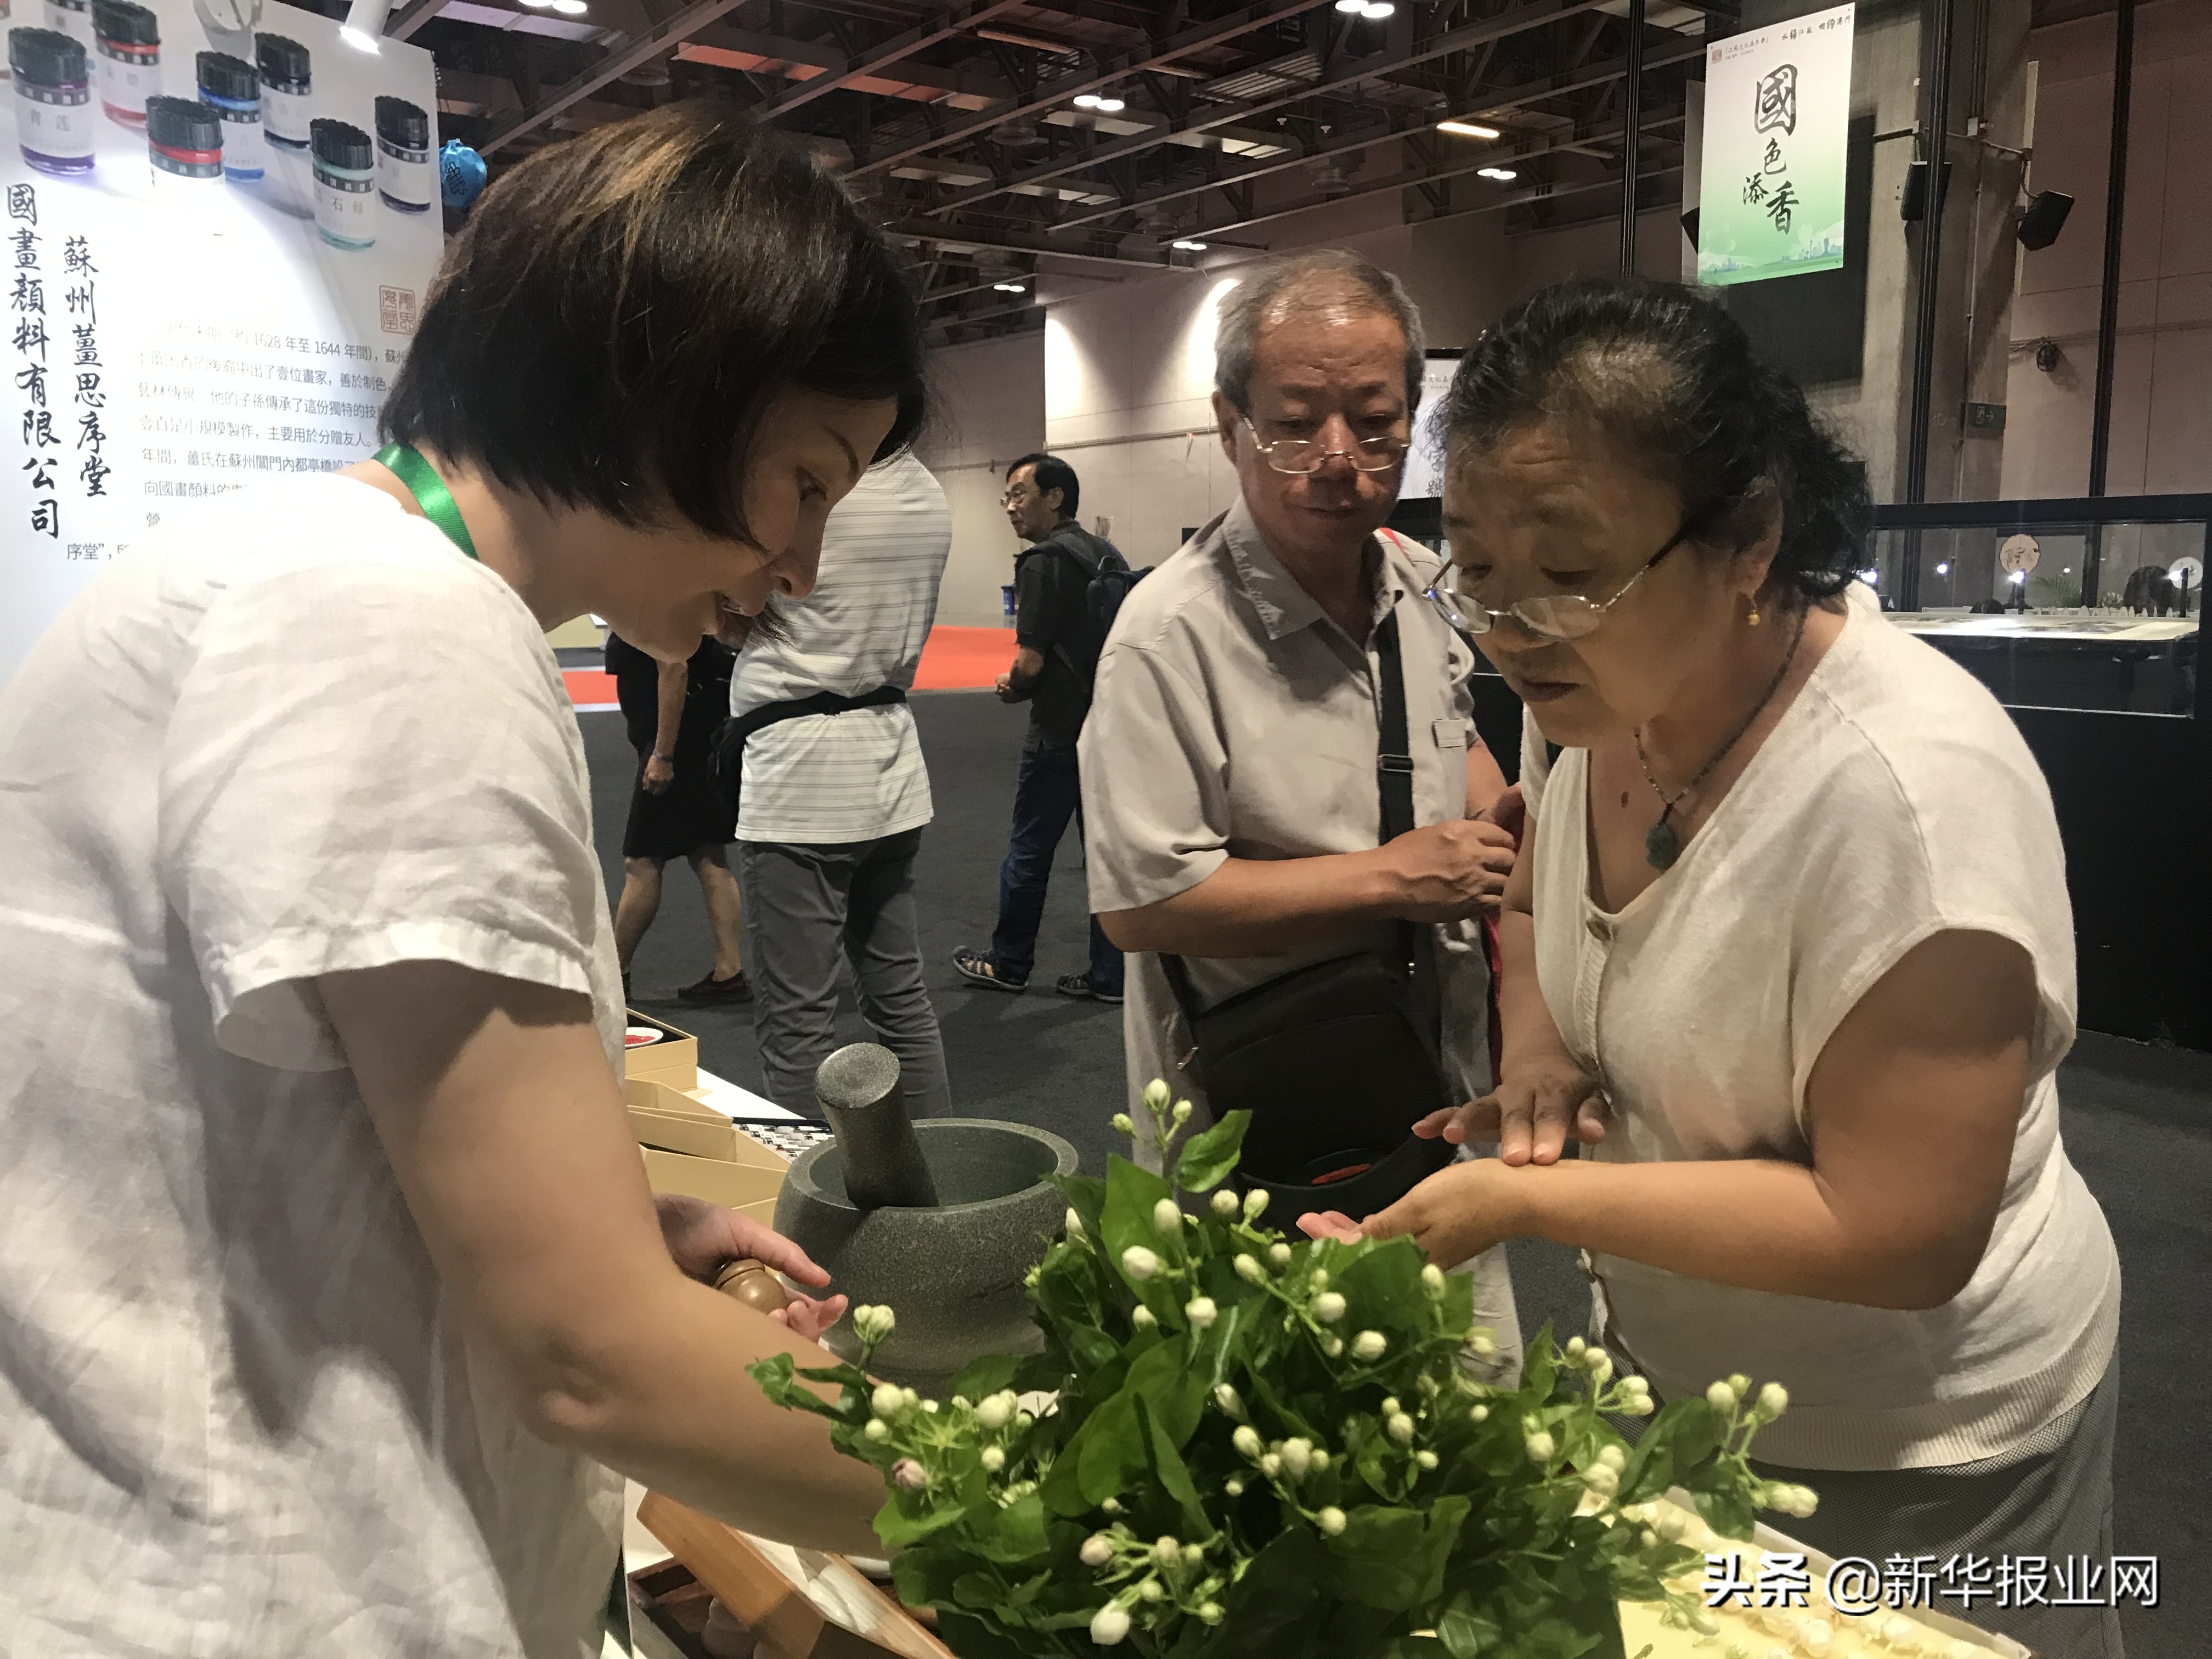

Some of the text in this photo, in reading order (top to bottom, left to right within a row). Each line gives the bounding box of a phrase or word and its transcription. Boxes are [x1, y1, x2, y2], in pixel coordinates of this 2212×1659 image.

[254, 333, 281, 348] 1628
[285, 336, 311, 353] 年至
[314, 341, 341, 356] 1644
